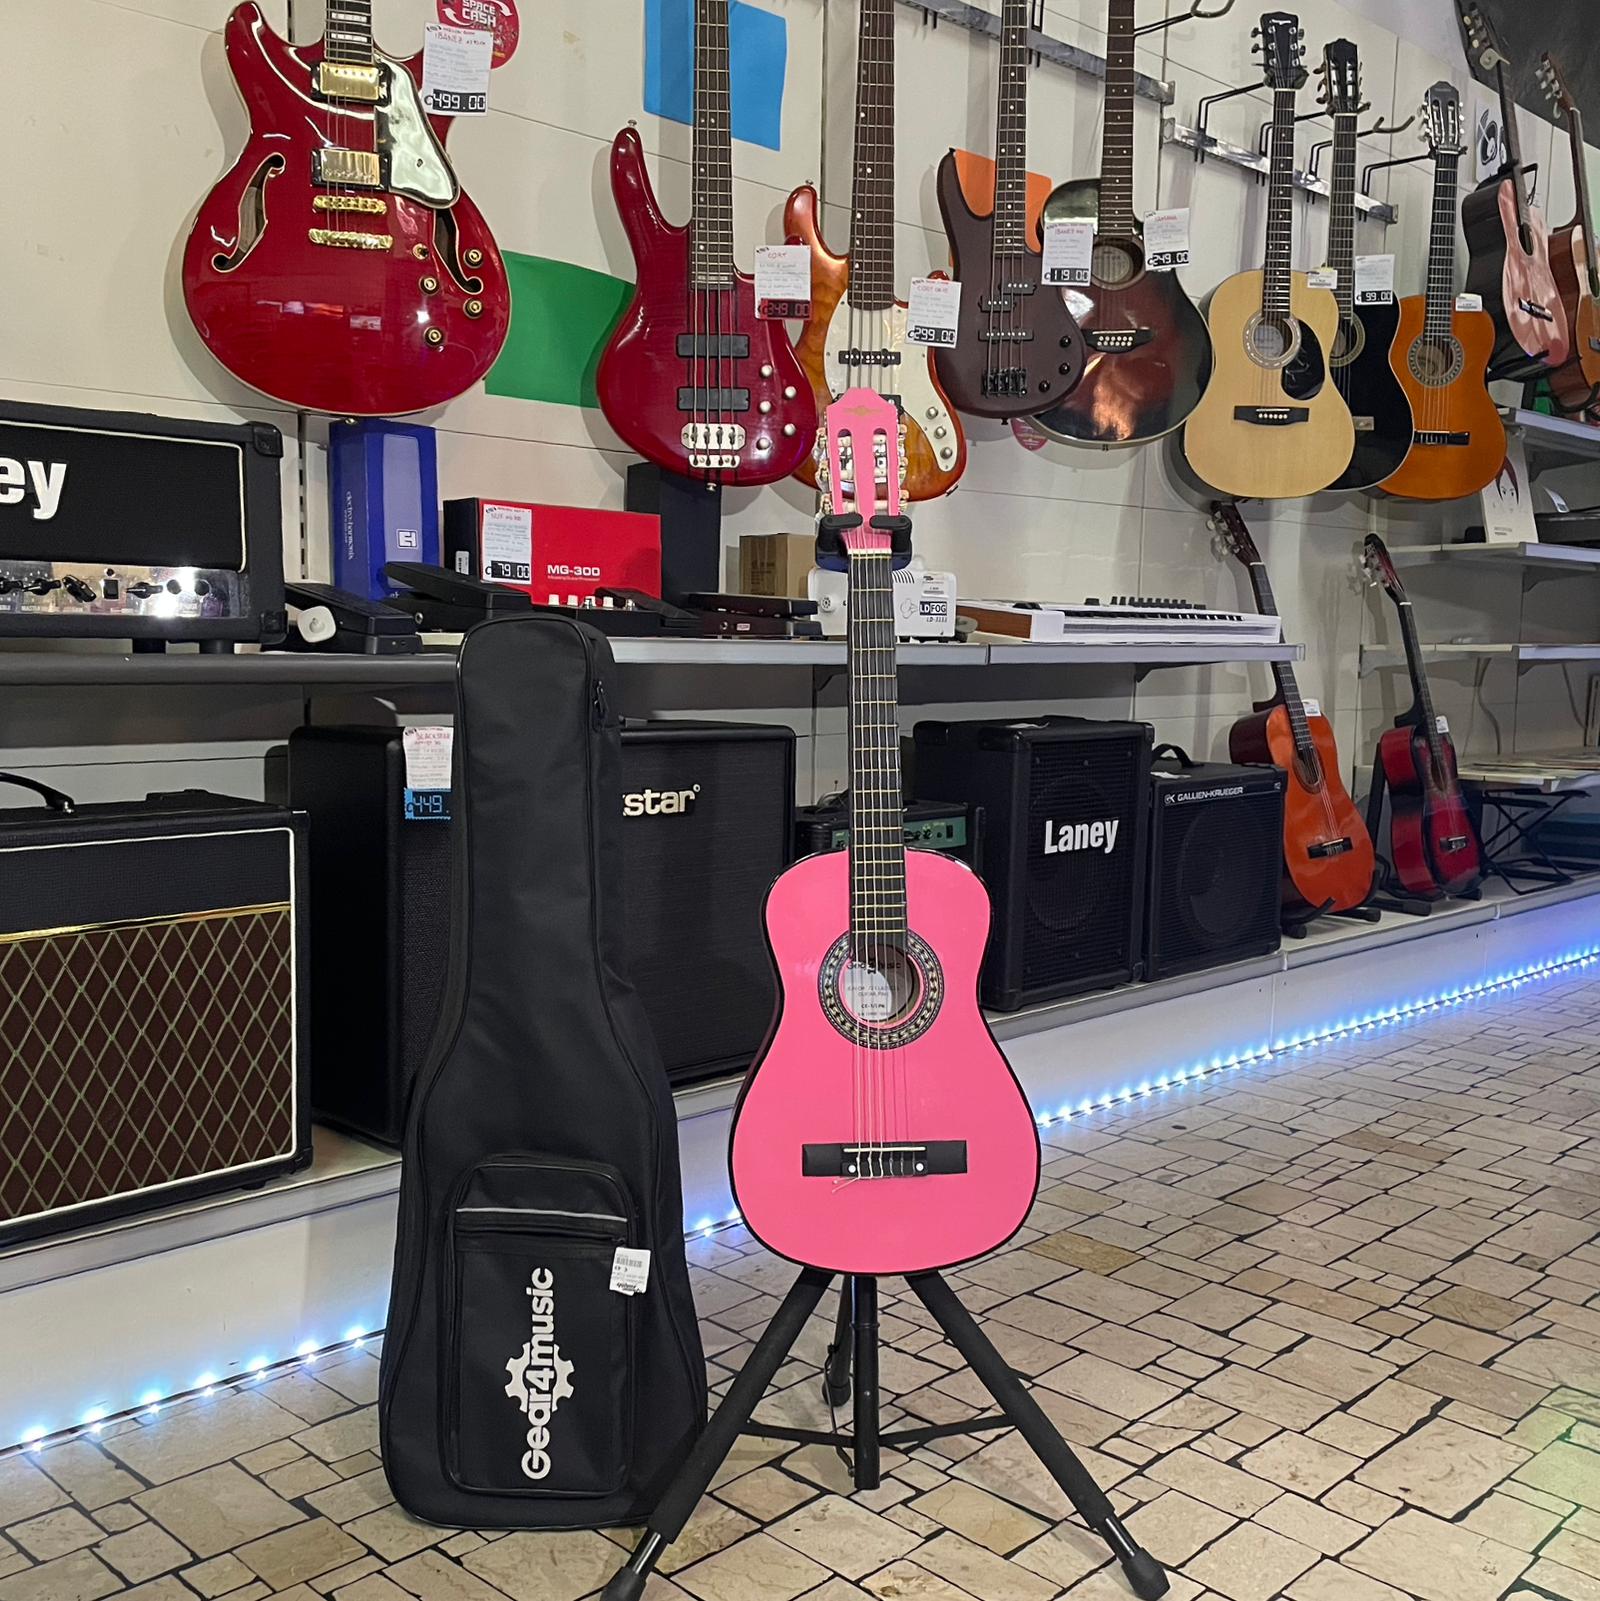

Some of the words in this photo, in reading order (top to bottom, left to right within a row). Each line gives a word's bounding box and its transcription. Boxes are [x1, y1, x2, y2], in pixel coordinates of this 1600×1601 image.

[463, 0, 495, 15] SPACE
[462, 8, 496, 27] CASH
[547, 564, 600, 577] MG-300
[623, 788, 696, 816] star
[1177, 787, 1244, 801] GALLIEN-KRUEGER
[1044, 820, 1119, 854] Laney
[521, 1267, 555, 1480] Gear4music
